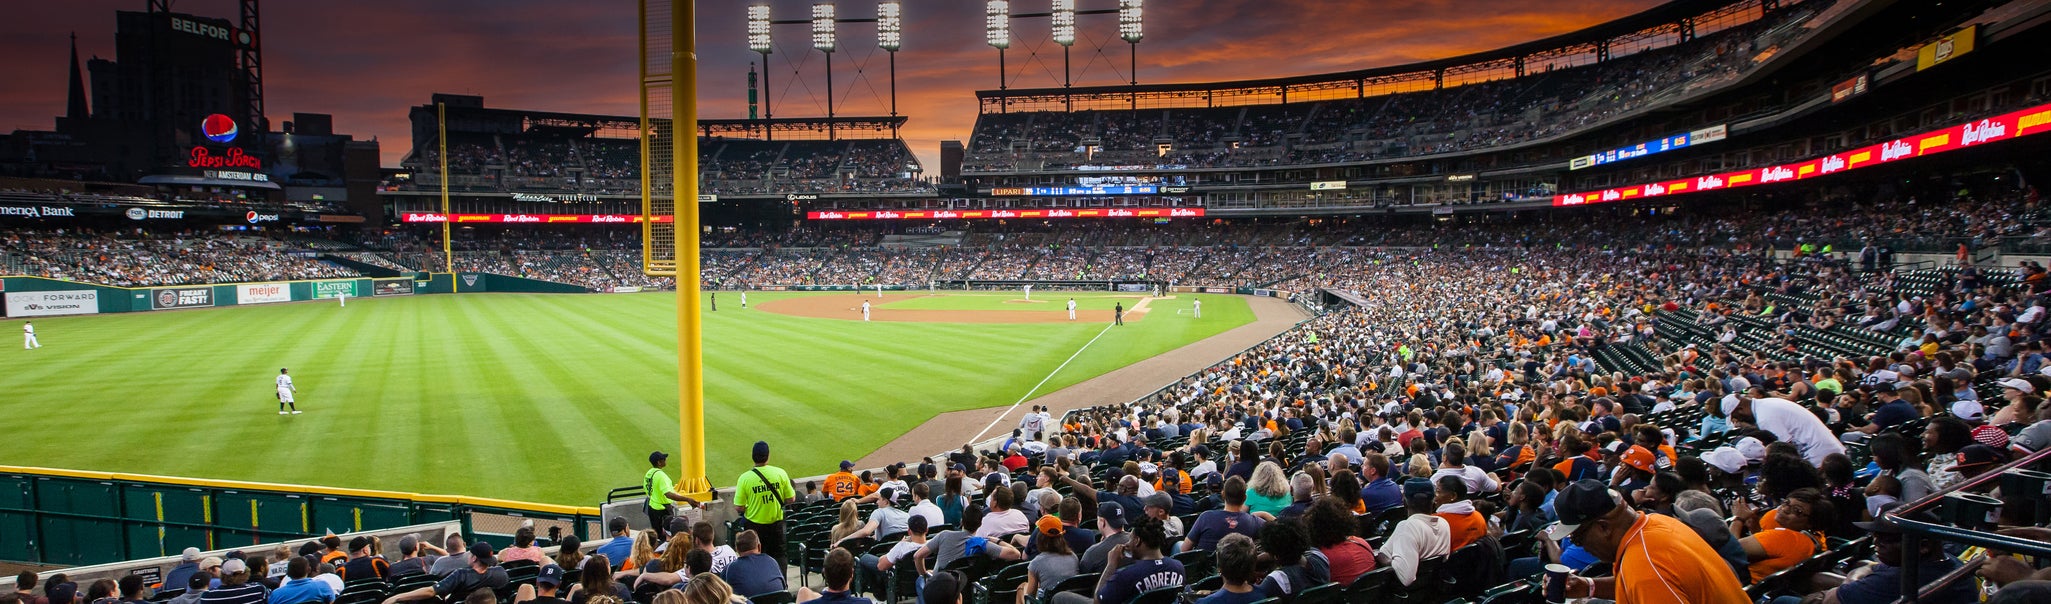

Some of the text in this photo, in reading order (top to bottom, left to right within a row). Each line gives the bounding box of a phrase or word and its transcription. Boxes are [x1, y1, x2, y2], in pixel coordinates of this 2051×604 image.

[171, 17, 230, 41] BELFOR
[218, 170, 251, 180] AMSTERDAM
[41, 206, 75, 216] Bank
[148, 210, 184, 219] DETROIT
[409, 214, 425, 222] Red
[249, 286, 280, 297] meijer
[317, 282, 353, 291] EASTERN
[43, 293, 96, 301] FORWARD
[178, 296, 208, 305] FAST!
[836, 481, 854, 493] 24
[762, 493, 774, 505] 114
[1135, 571, 1184, 594] CABRERA
